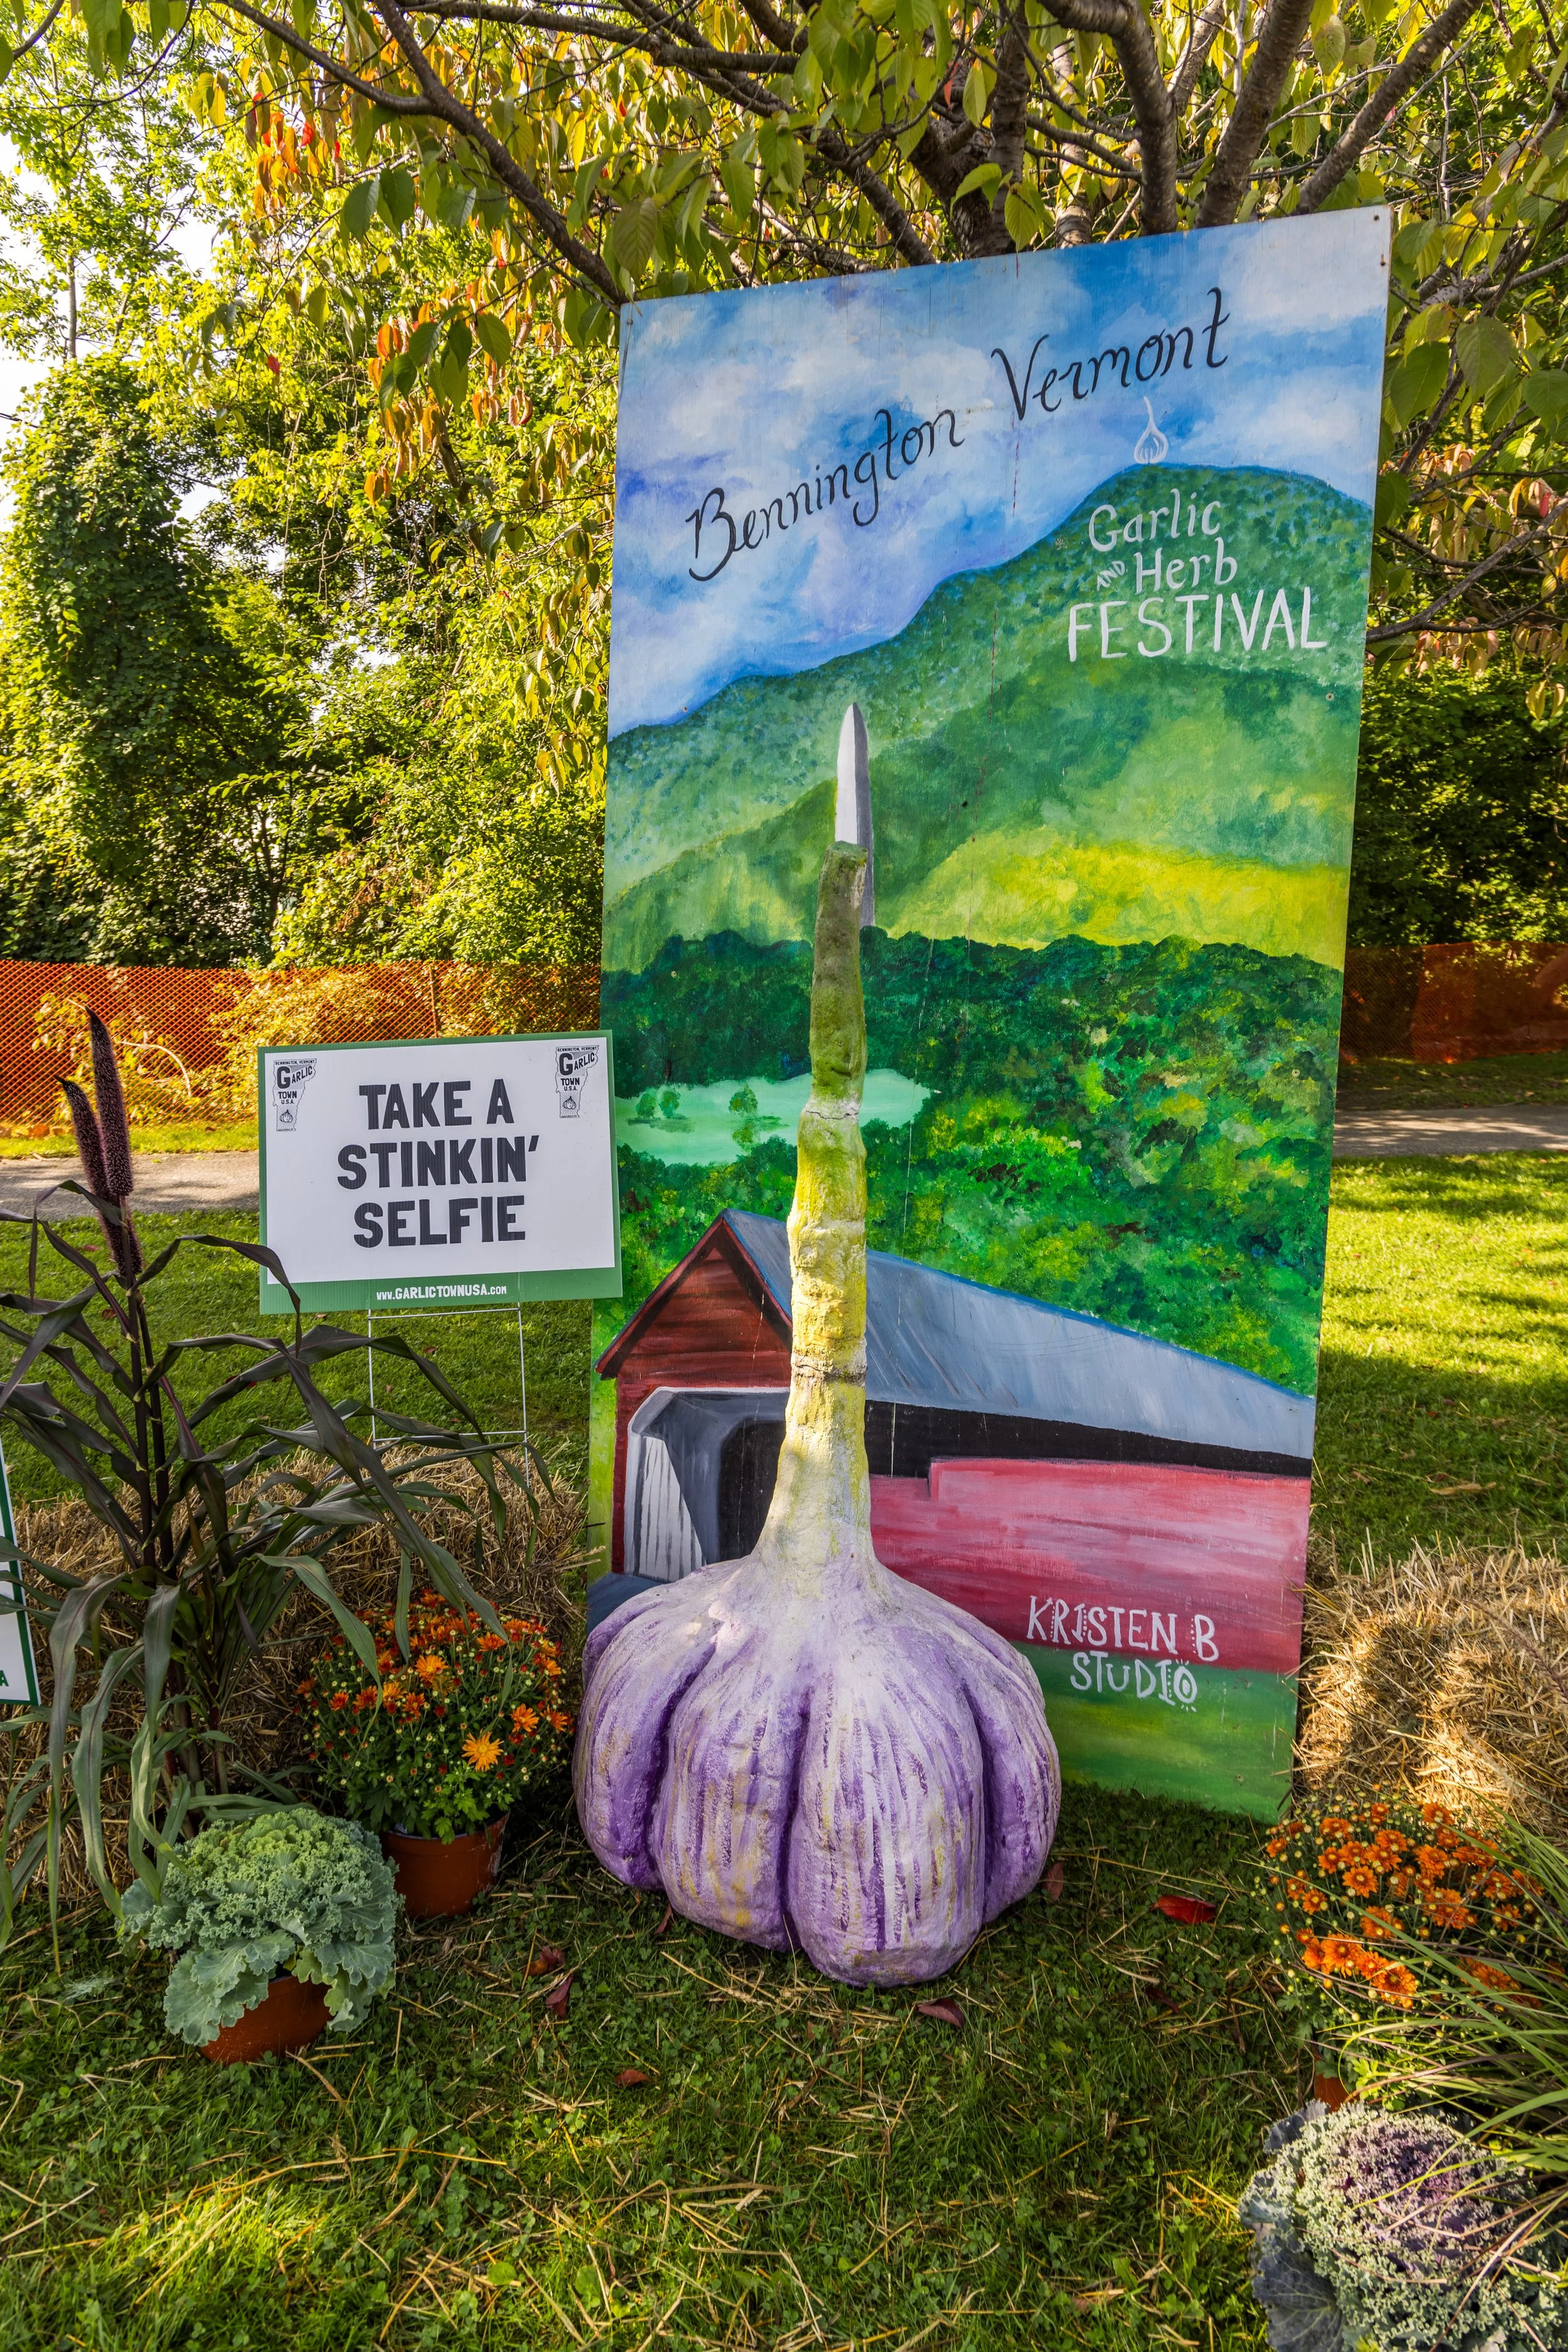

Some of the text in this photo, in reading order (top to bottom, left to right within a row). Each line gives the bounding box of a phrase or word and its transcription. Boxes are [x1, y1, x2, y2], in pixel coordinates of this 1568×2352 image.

[685, 287, 1231, 582] Bennington Vermont
[1088, 488, 1221, 552] Garlic
[1133, 536, 1238, 595] Herb
[1067, 586, 1328, 663] FESTIVAL
[277, 1065, 313, 1089] GARLIC
[559, 1052, 595, 1076] GARLIC
[560, 1077, 580, 1086] TOWN
[278, 1090, 297, 1099] TOWN
[358, 1078, 514, 1130] TAKE A
[337, 1135, 539, 1189] STINKIN'
[353, 1195, 526, 1248] SELFIE
[1026, 1595, 1219, 1662] KRISTEN B
[1070, 1651, 1198, 1707] STUDIO
